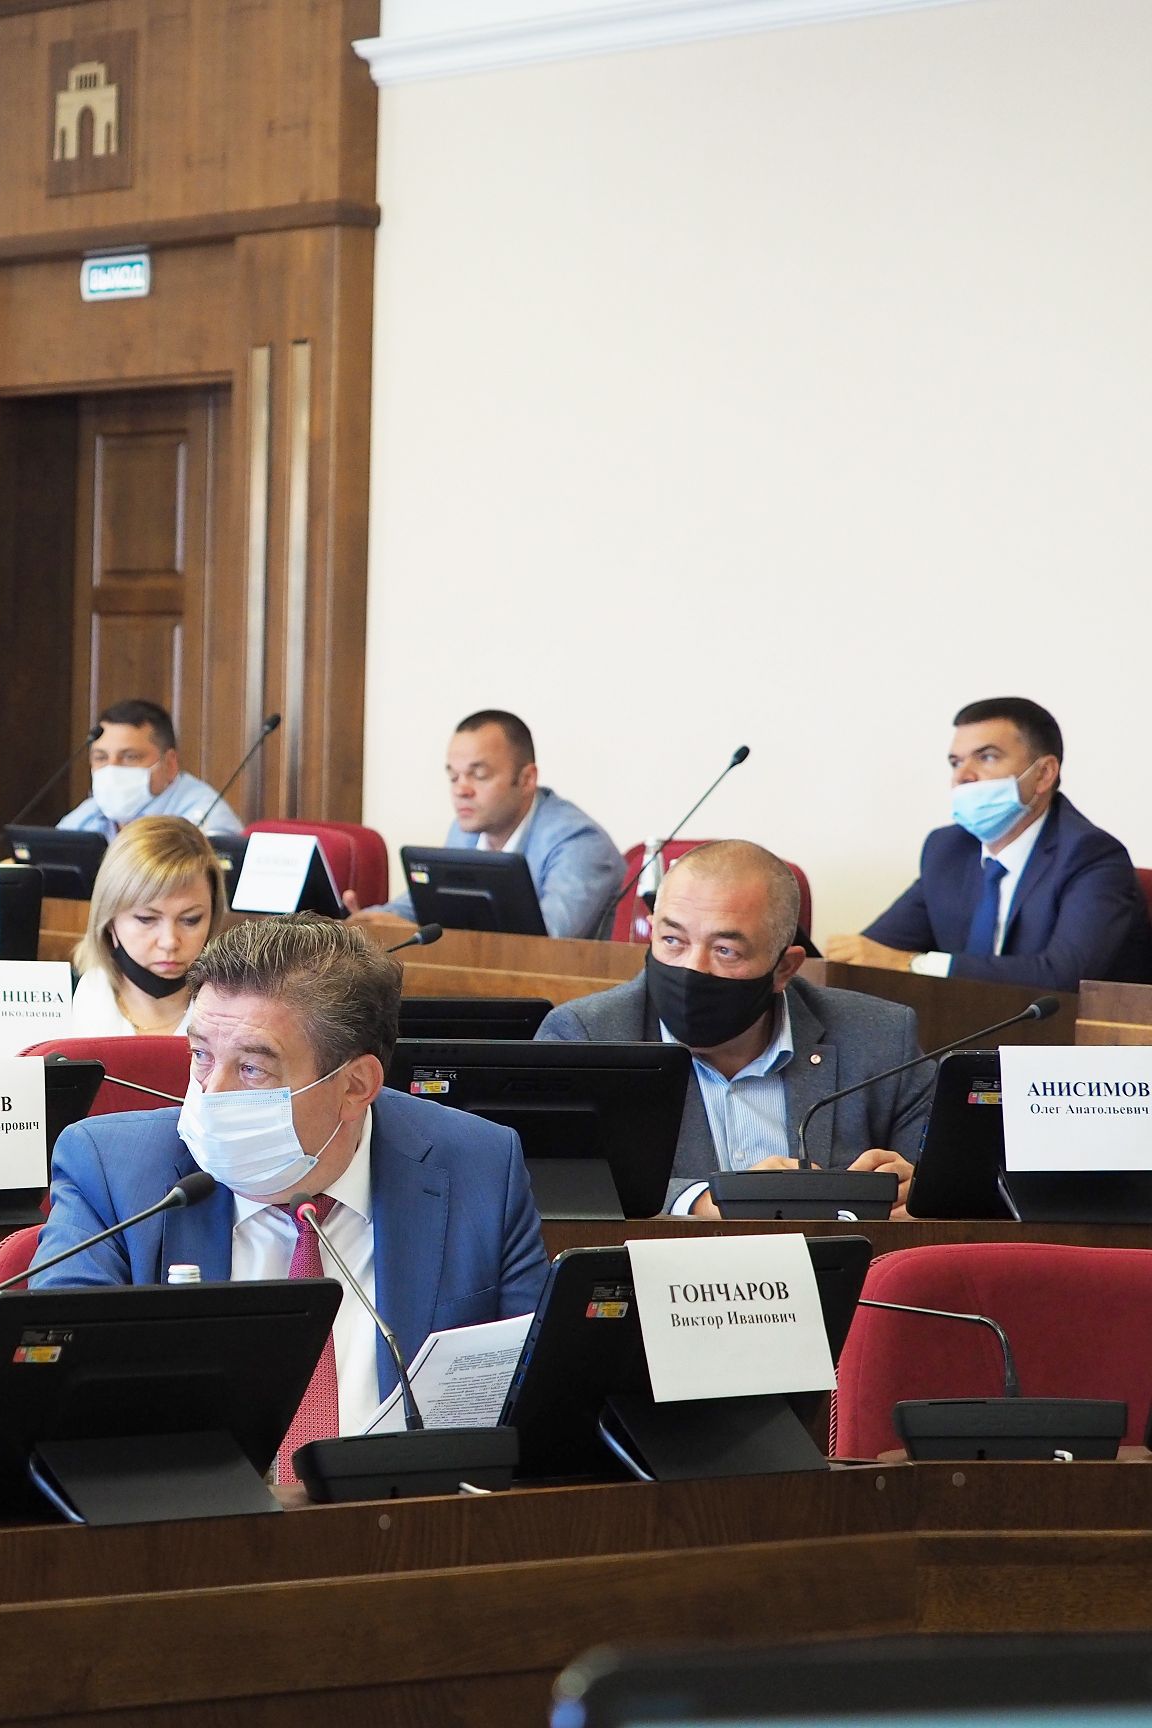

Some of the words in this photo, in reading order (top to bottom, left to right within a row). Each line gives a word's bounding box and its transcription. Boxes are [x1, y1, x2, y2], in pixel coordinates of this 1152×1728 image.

[1027, 1081, 1150, 1097] АНИСИМОВ
[1030, 1103, 1061, 1115] Олег
[1065, 1104, 1150, 1115] Анатольевич
[669, 1281, 790, 1304] ГОНЧАРОВ
[671, 1312, 724, 1329] Виктор
[727, 1311, 798, 1326] Иванович
